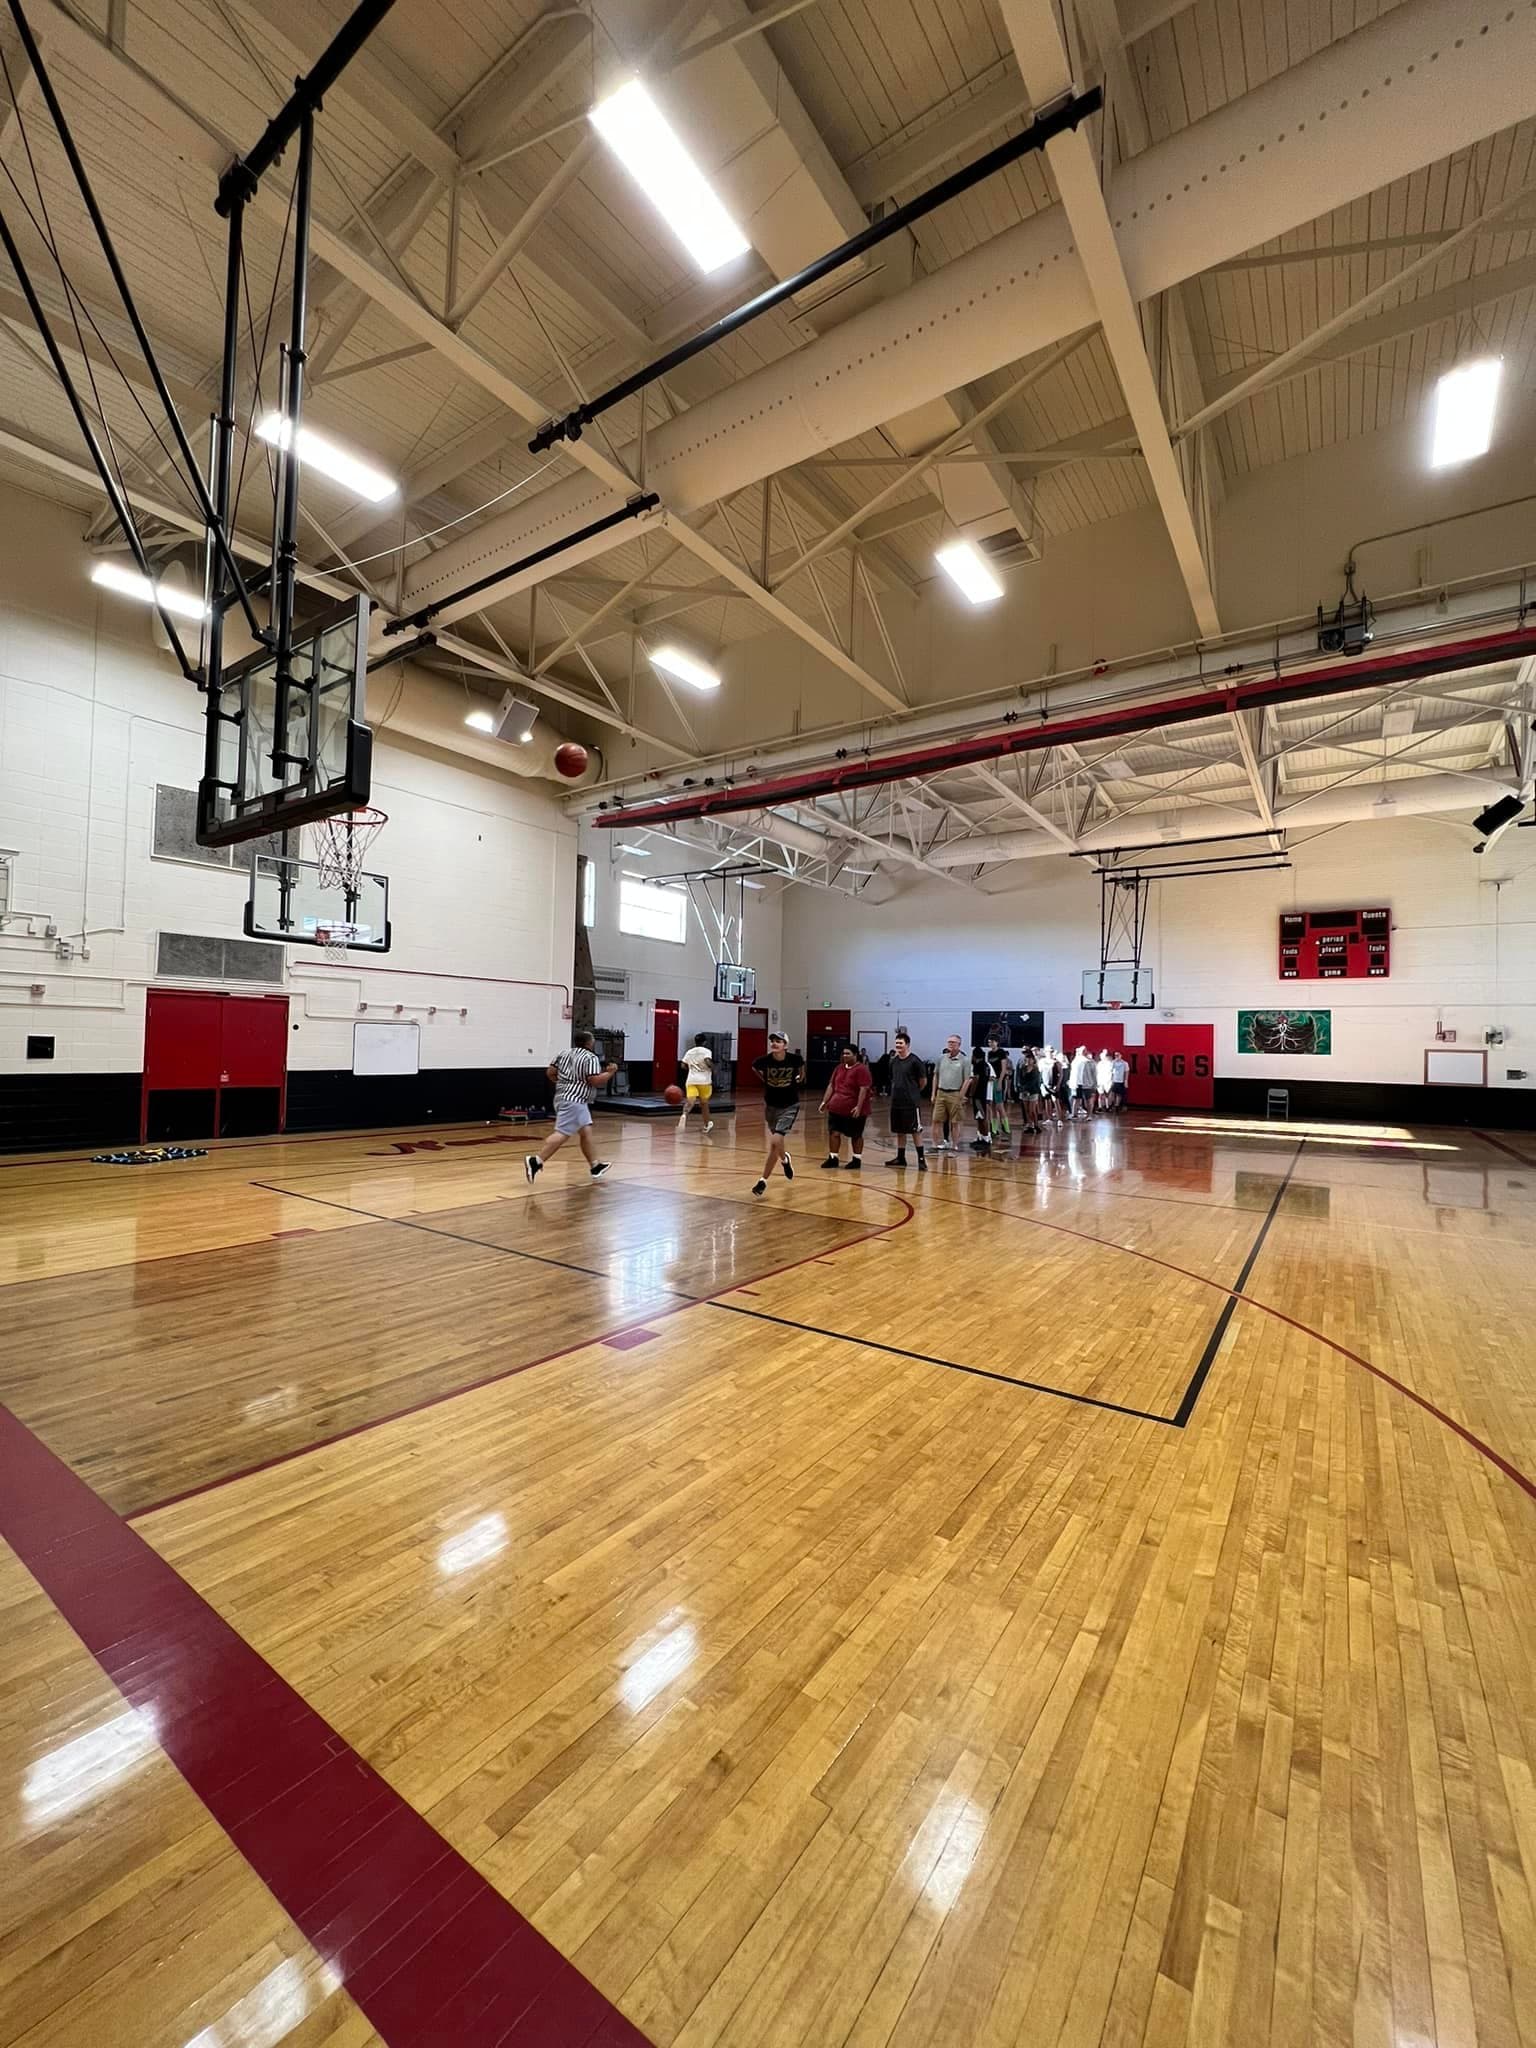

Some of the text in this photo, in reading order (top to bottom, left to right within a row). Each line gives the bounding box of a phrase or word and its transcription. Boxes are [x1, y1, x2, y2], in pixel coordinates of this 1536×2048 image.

[1322, 935, 1344, 943] period
[1321, 945, 1344, 954] player
[1131, 1054, 1209, 1077] INGS
